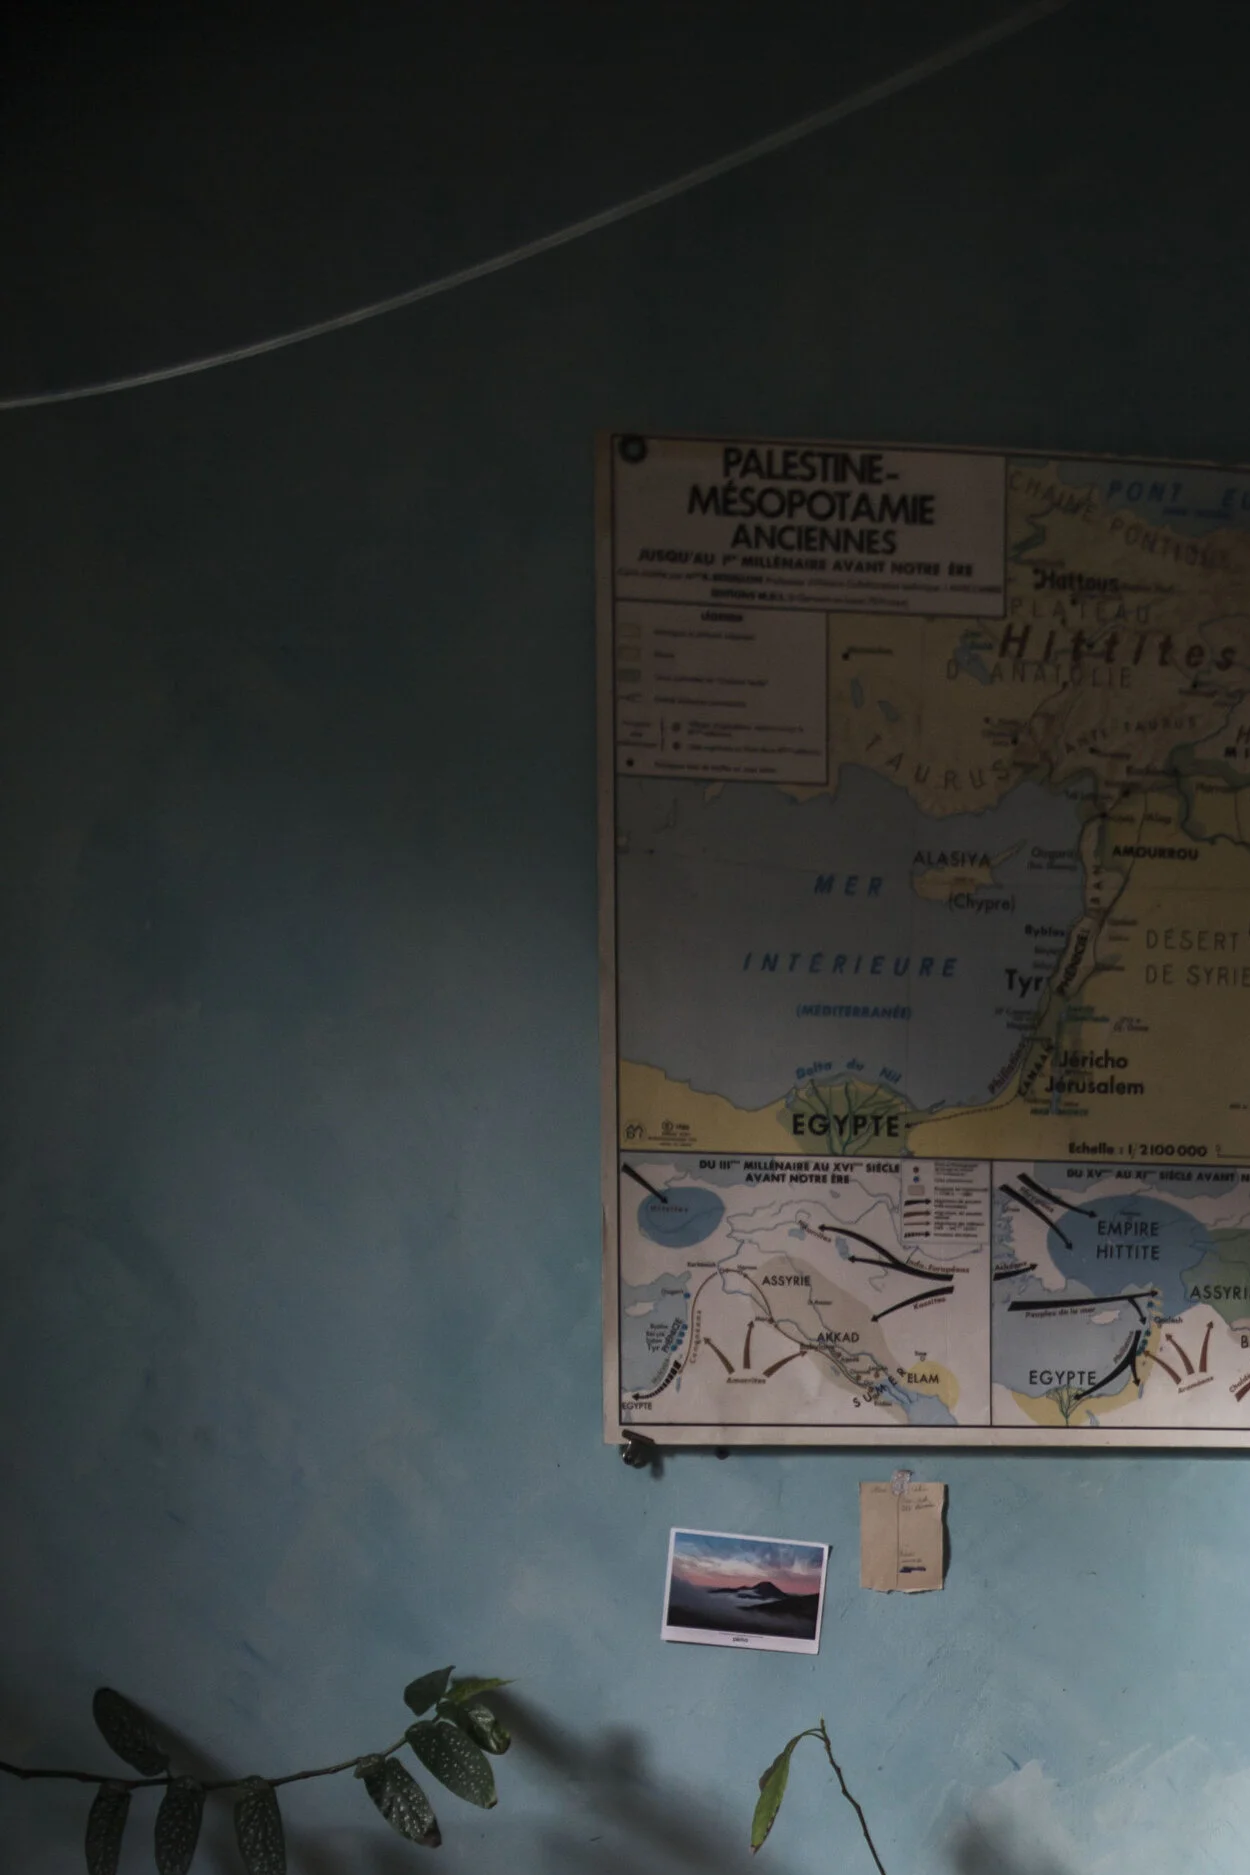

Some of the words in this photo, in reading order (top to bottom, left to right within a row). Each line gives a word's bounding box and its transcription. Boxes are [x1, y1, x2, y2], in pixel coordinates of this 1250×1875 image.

[723, 447, 899, 484] PALESTINE-
[1107, 479, 1184, 502] PONT
[687, 480, 936, 526] MÉSOPOTAMIE
[731, 524, 897, 555] ANCIENNES
[638, 549, 714, 566] JUSQU'AU
[741, 553, 826, 571] MILLÉNAIRE
[832, 559, 885, 574] AVANT
[891, 562, 940, 576] NOTRE
[998, 623, 1237, 671] Hittites
[912, 849, 991, 867] ALASIYA
[813, 873, 885, 898] MER
[1145, 964, 1174, 985] DE
[846, 1057, 865, 1071] du
[879, 1065, 903, 1086] Nil
[1044, 1074, 1145, 1096] Jérusalem
[791, 1111, 901, 1138] EGYPTE
[699, 1159, 717, 1171] DU
[743, 1159, 810, 1172] MILLÉNAIRE
[813, 1162, 829, 1172] AU
[1067, 1169, 1082, 1179] DU
[1115, 1170, 1130, 1180] AU
[1196, 1171, 1236, 1183] AVANT
[745, 1173, 787, 1184] AVANT
[789, 1173, 825, 1184] NOTRE
[1098, 1220, 1160, 1237] EMPIRE
[1096, 1244, 1160, 1261] HITTITE
[762, 1275, 811, 1287] ASSYRIE
[817, 1332, 860, 1343] AKKAD
[907, 1373, 940, 1384] ELAM
[1028, 1370, 1097, 1386] EGYPTE
